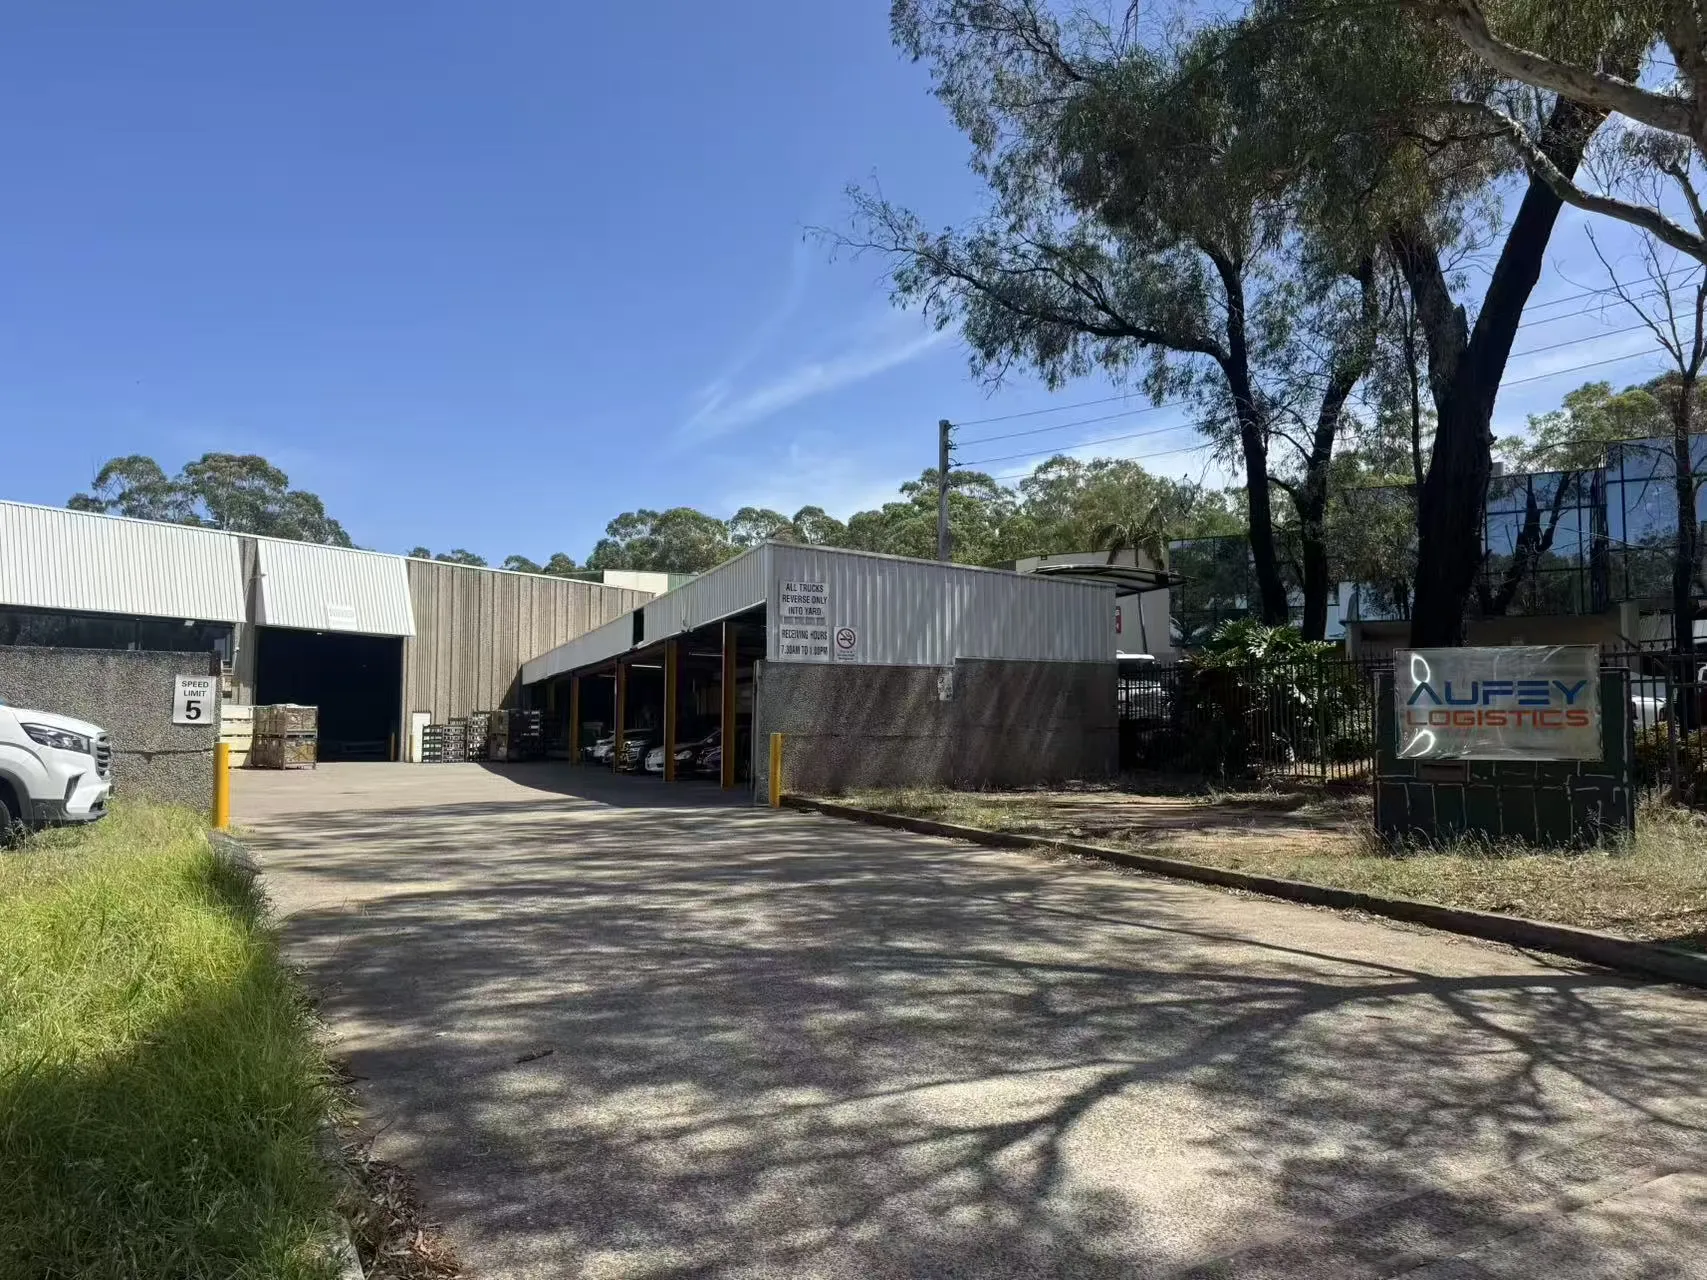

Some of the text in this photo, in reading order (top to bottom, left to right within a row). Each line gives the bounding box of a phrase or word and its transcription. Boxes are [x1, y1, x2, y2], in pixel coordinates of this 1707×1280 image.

[785, 583, 824, 592] ALL TRUCKS
[782, 594, 828, 605] REVERSE ONLY
[788, 607, 822, 616] INTO YARD
[781, 629, 809, 640] RECEIVING
[801, 645, 809, 656] TO
[181, 680, 209, 688] SPEED
[1406, 680, 1589, 706] AUFEY
[185, 700, 202, 720] 5
[1406, 709, 1590, 728] LOGISTICS
